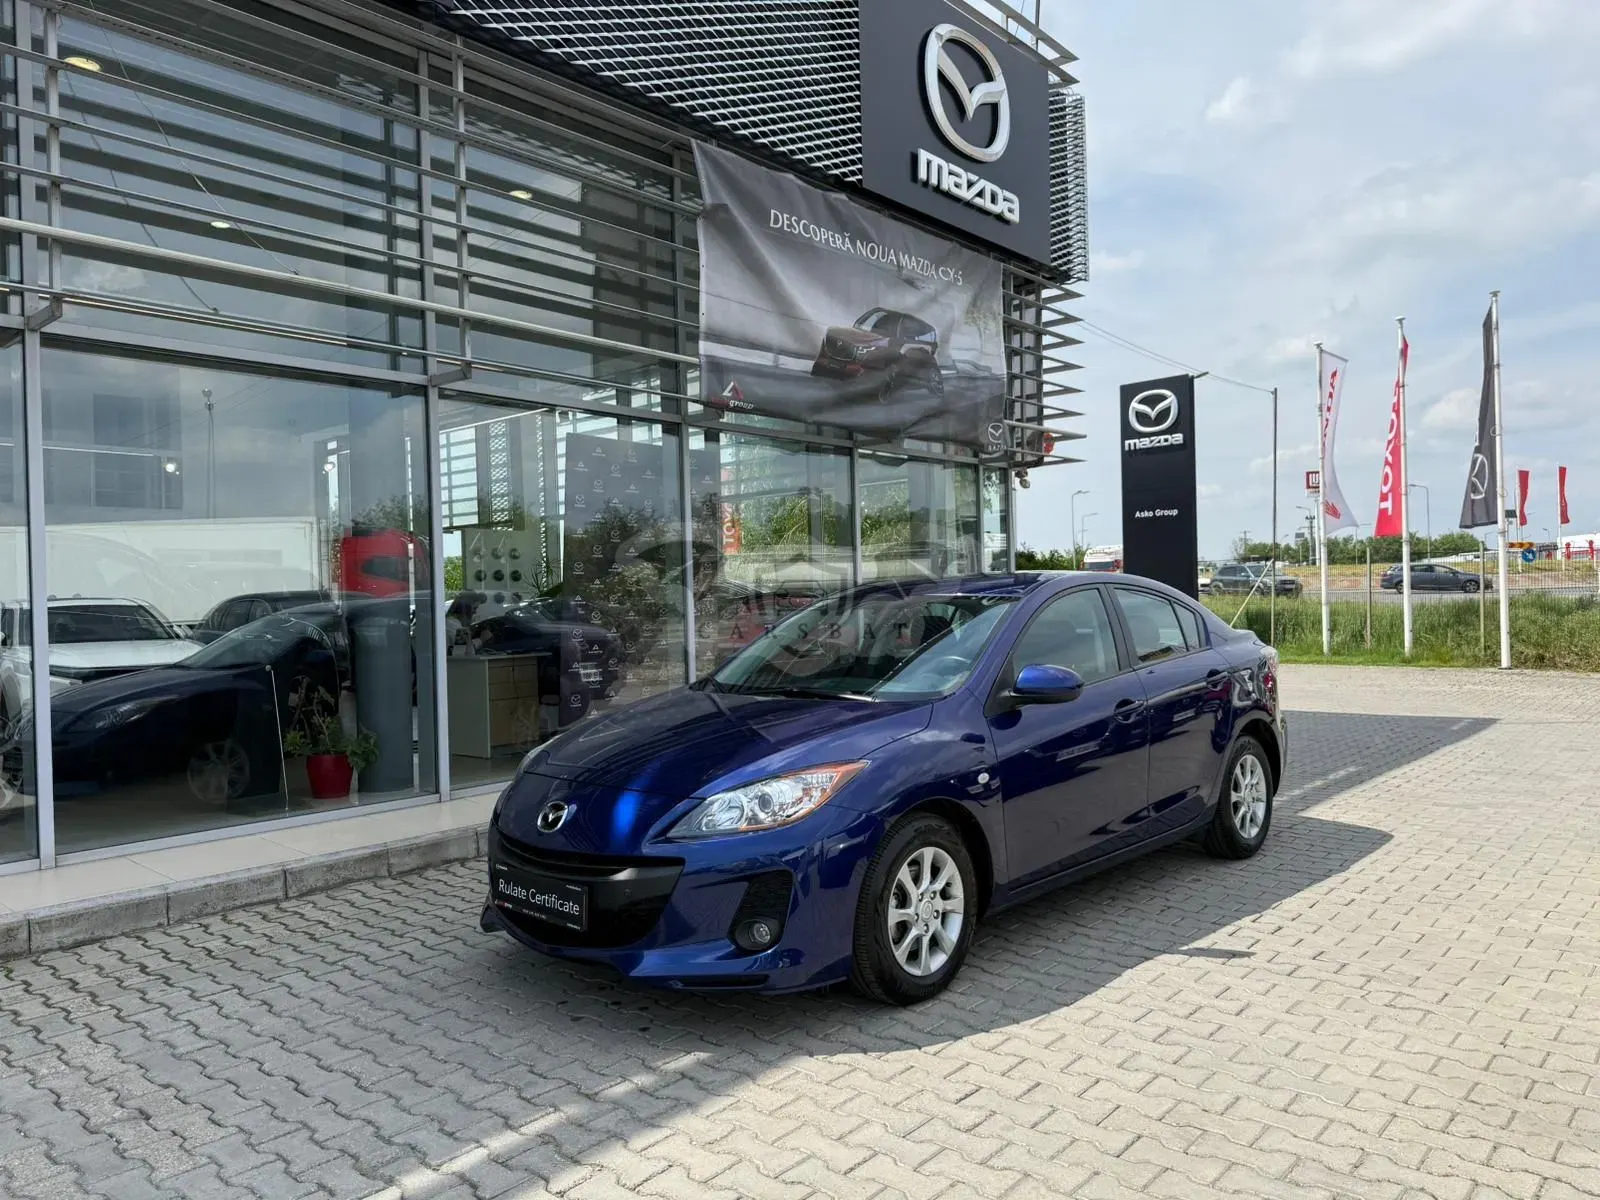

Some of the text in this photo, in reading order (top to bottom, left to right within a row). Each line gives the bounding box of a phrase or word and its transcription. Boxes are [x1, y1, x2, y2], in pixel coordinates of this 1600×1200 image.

[769, 208, 854, 254] DESCOPERĂ
[856, 239, 897, 265] NOUA
[899, 251, 937, 280] MAZDA
[1134, 509, 1178, 518] Asko Group
[498, 878, 527, 900] Rulate
[528, 888, 580, 915] Certificate
